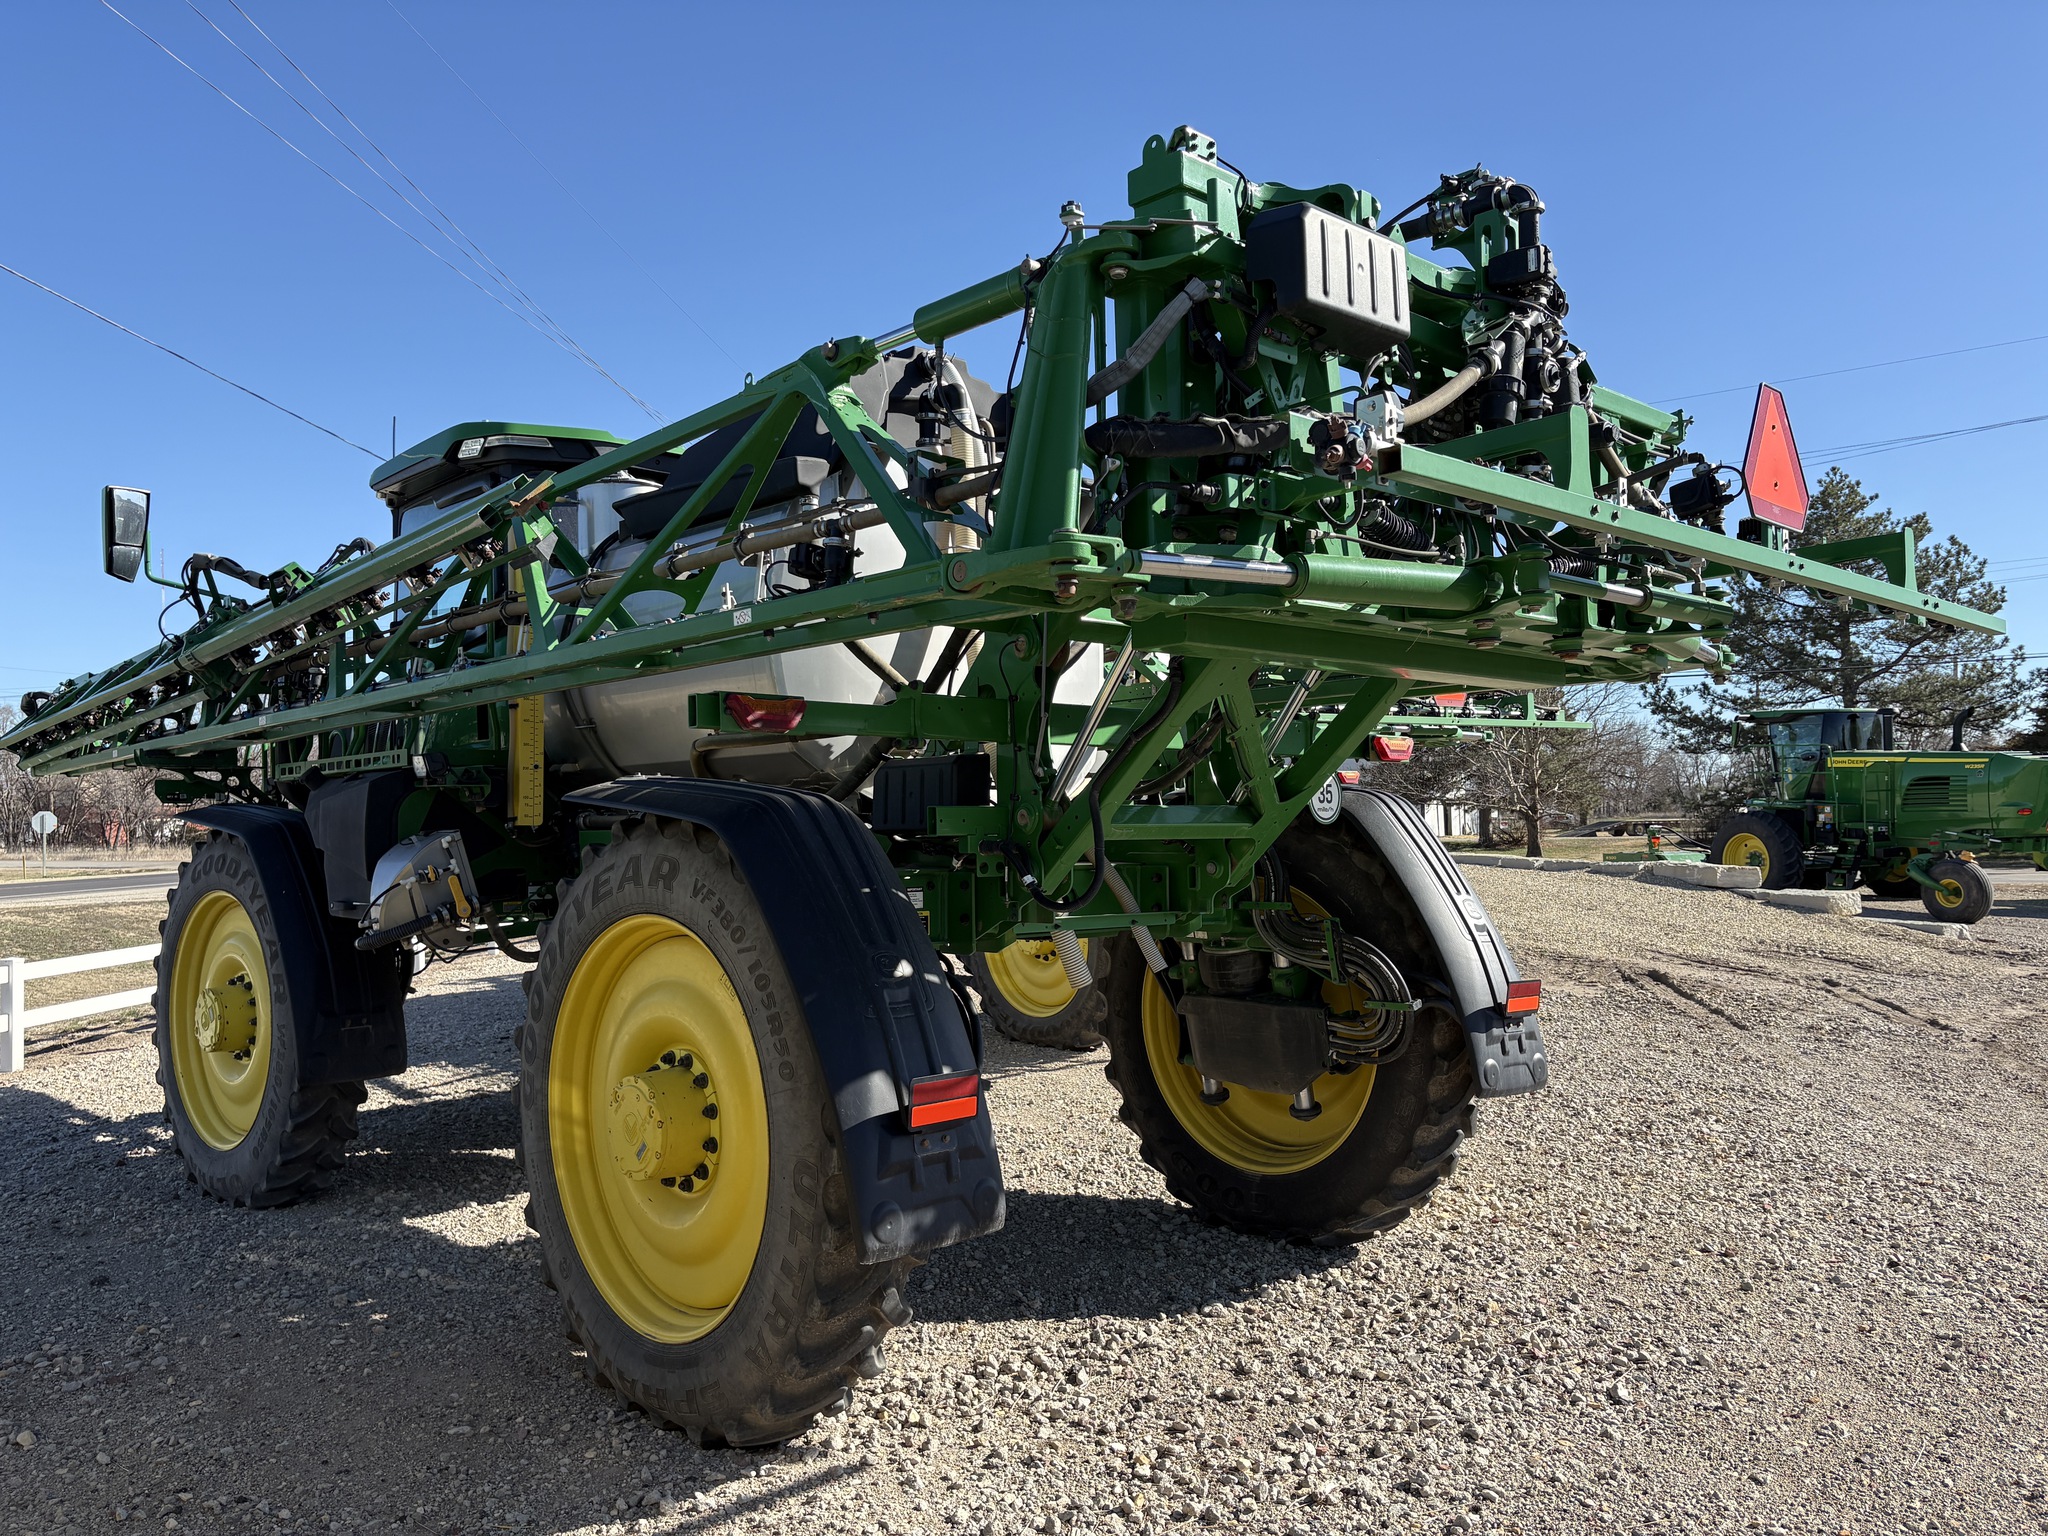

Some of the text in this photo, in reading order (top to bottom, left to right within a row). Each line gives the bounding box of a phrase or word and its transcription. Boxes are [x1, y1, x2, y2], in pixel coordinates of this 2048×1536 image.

[1318, 784, 1333, 804] 35
[191, 853, 289, 1005] GOODYEAR
[524, 853, 681, 1110] GOODYEAR
[691, 876, 795, 1082] VF380/105R50
